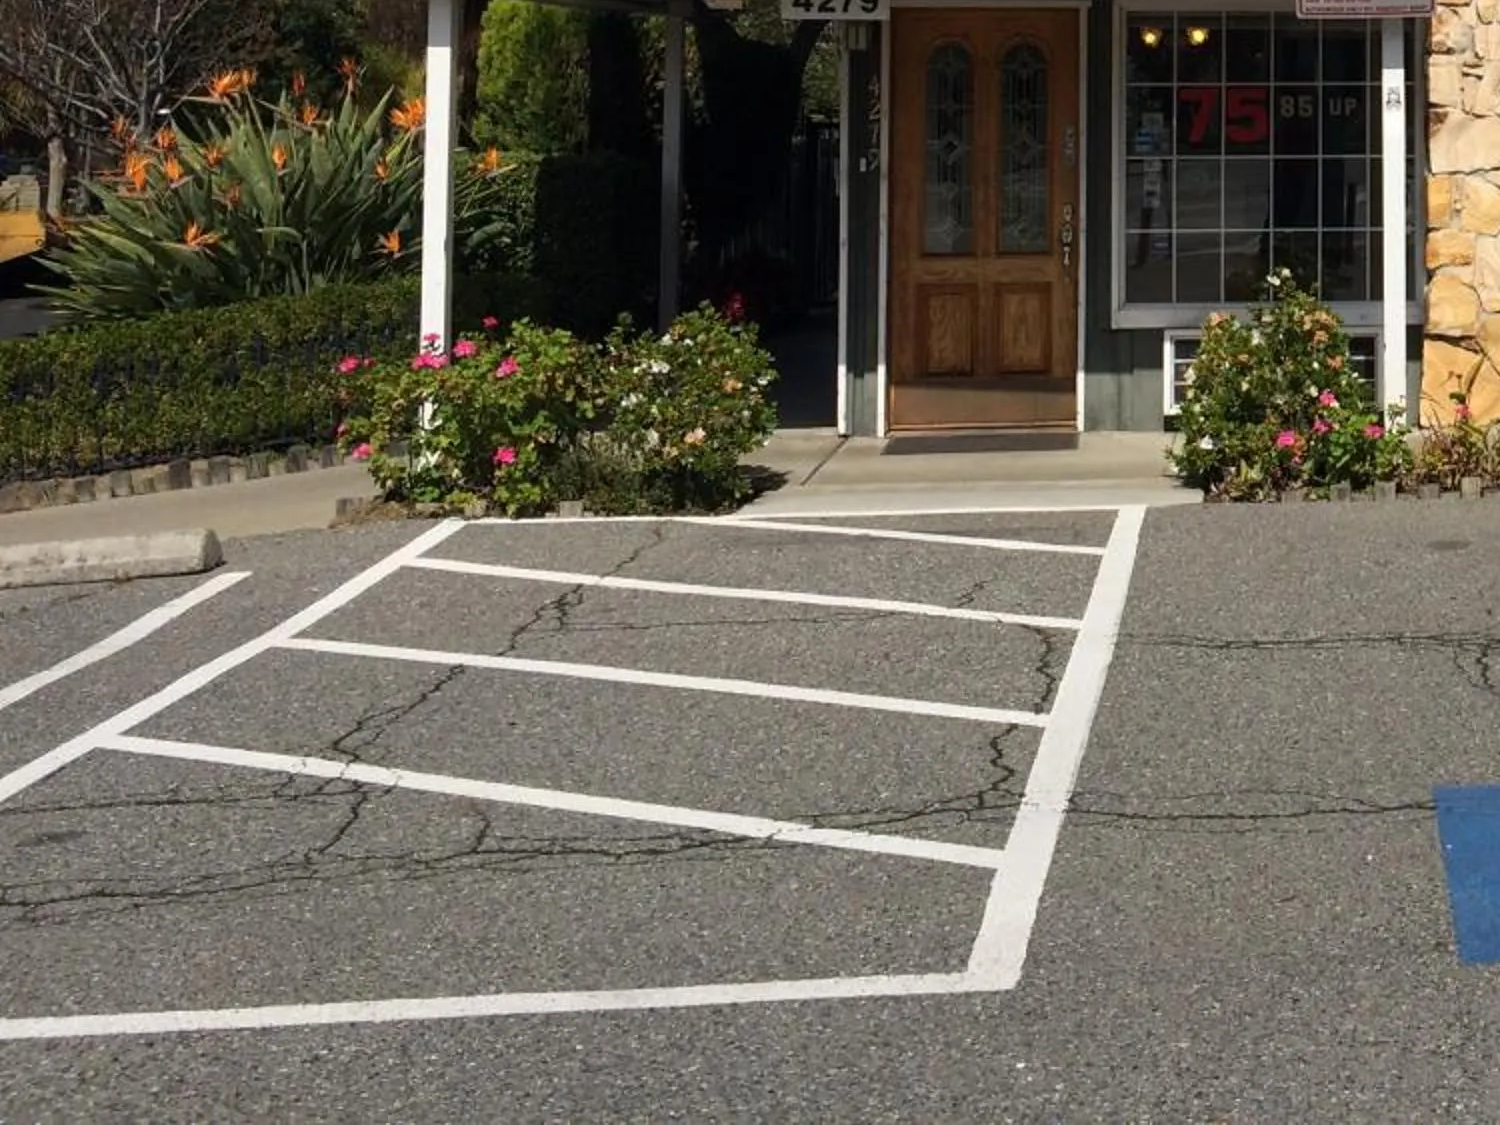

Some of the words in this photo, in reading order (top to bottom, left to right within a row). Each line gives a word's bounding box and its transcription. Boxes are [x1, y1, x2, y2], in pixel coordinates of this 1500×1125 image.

[1179, 87, 1269, 144] 75
[1280, 95, 1313, 118] 85
[1328, 96, 1358, 118] UP
